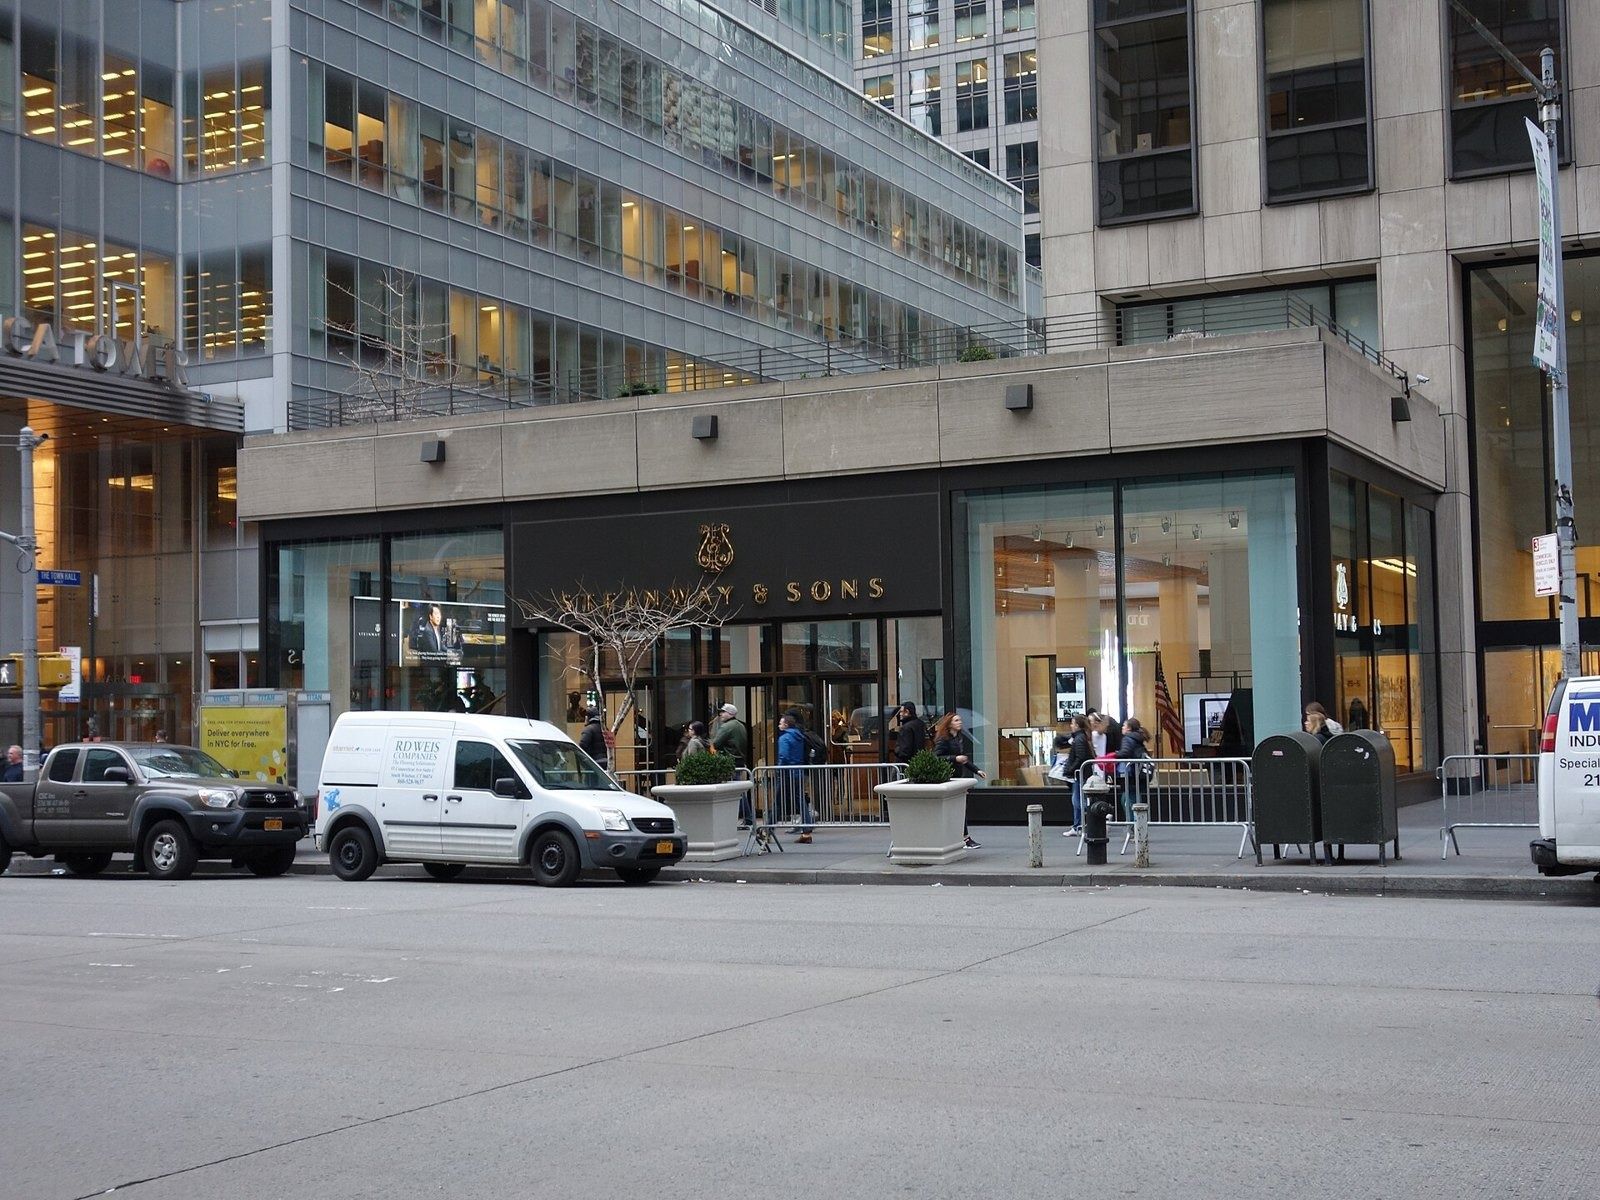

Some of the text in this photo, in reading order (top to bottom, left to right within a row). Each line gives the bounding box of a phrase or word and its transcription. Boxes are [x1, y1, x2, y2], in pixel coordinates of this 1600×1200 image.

[0, 313, 60, 362] CA
[40, 571, 77, 582] THE TOWN HALL
[752, 582, 769, 604] &
[786, 577, 886, 602] SONS
[207, 729, 270, 738] Deliver everywhere
[207, 740, 257, 748] in NYC for free.
[396, 740, 440, 752] RD WEIS
[393, 752, 438, 760] COMPANIES
